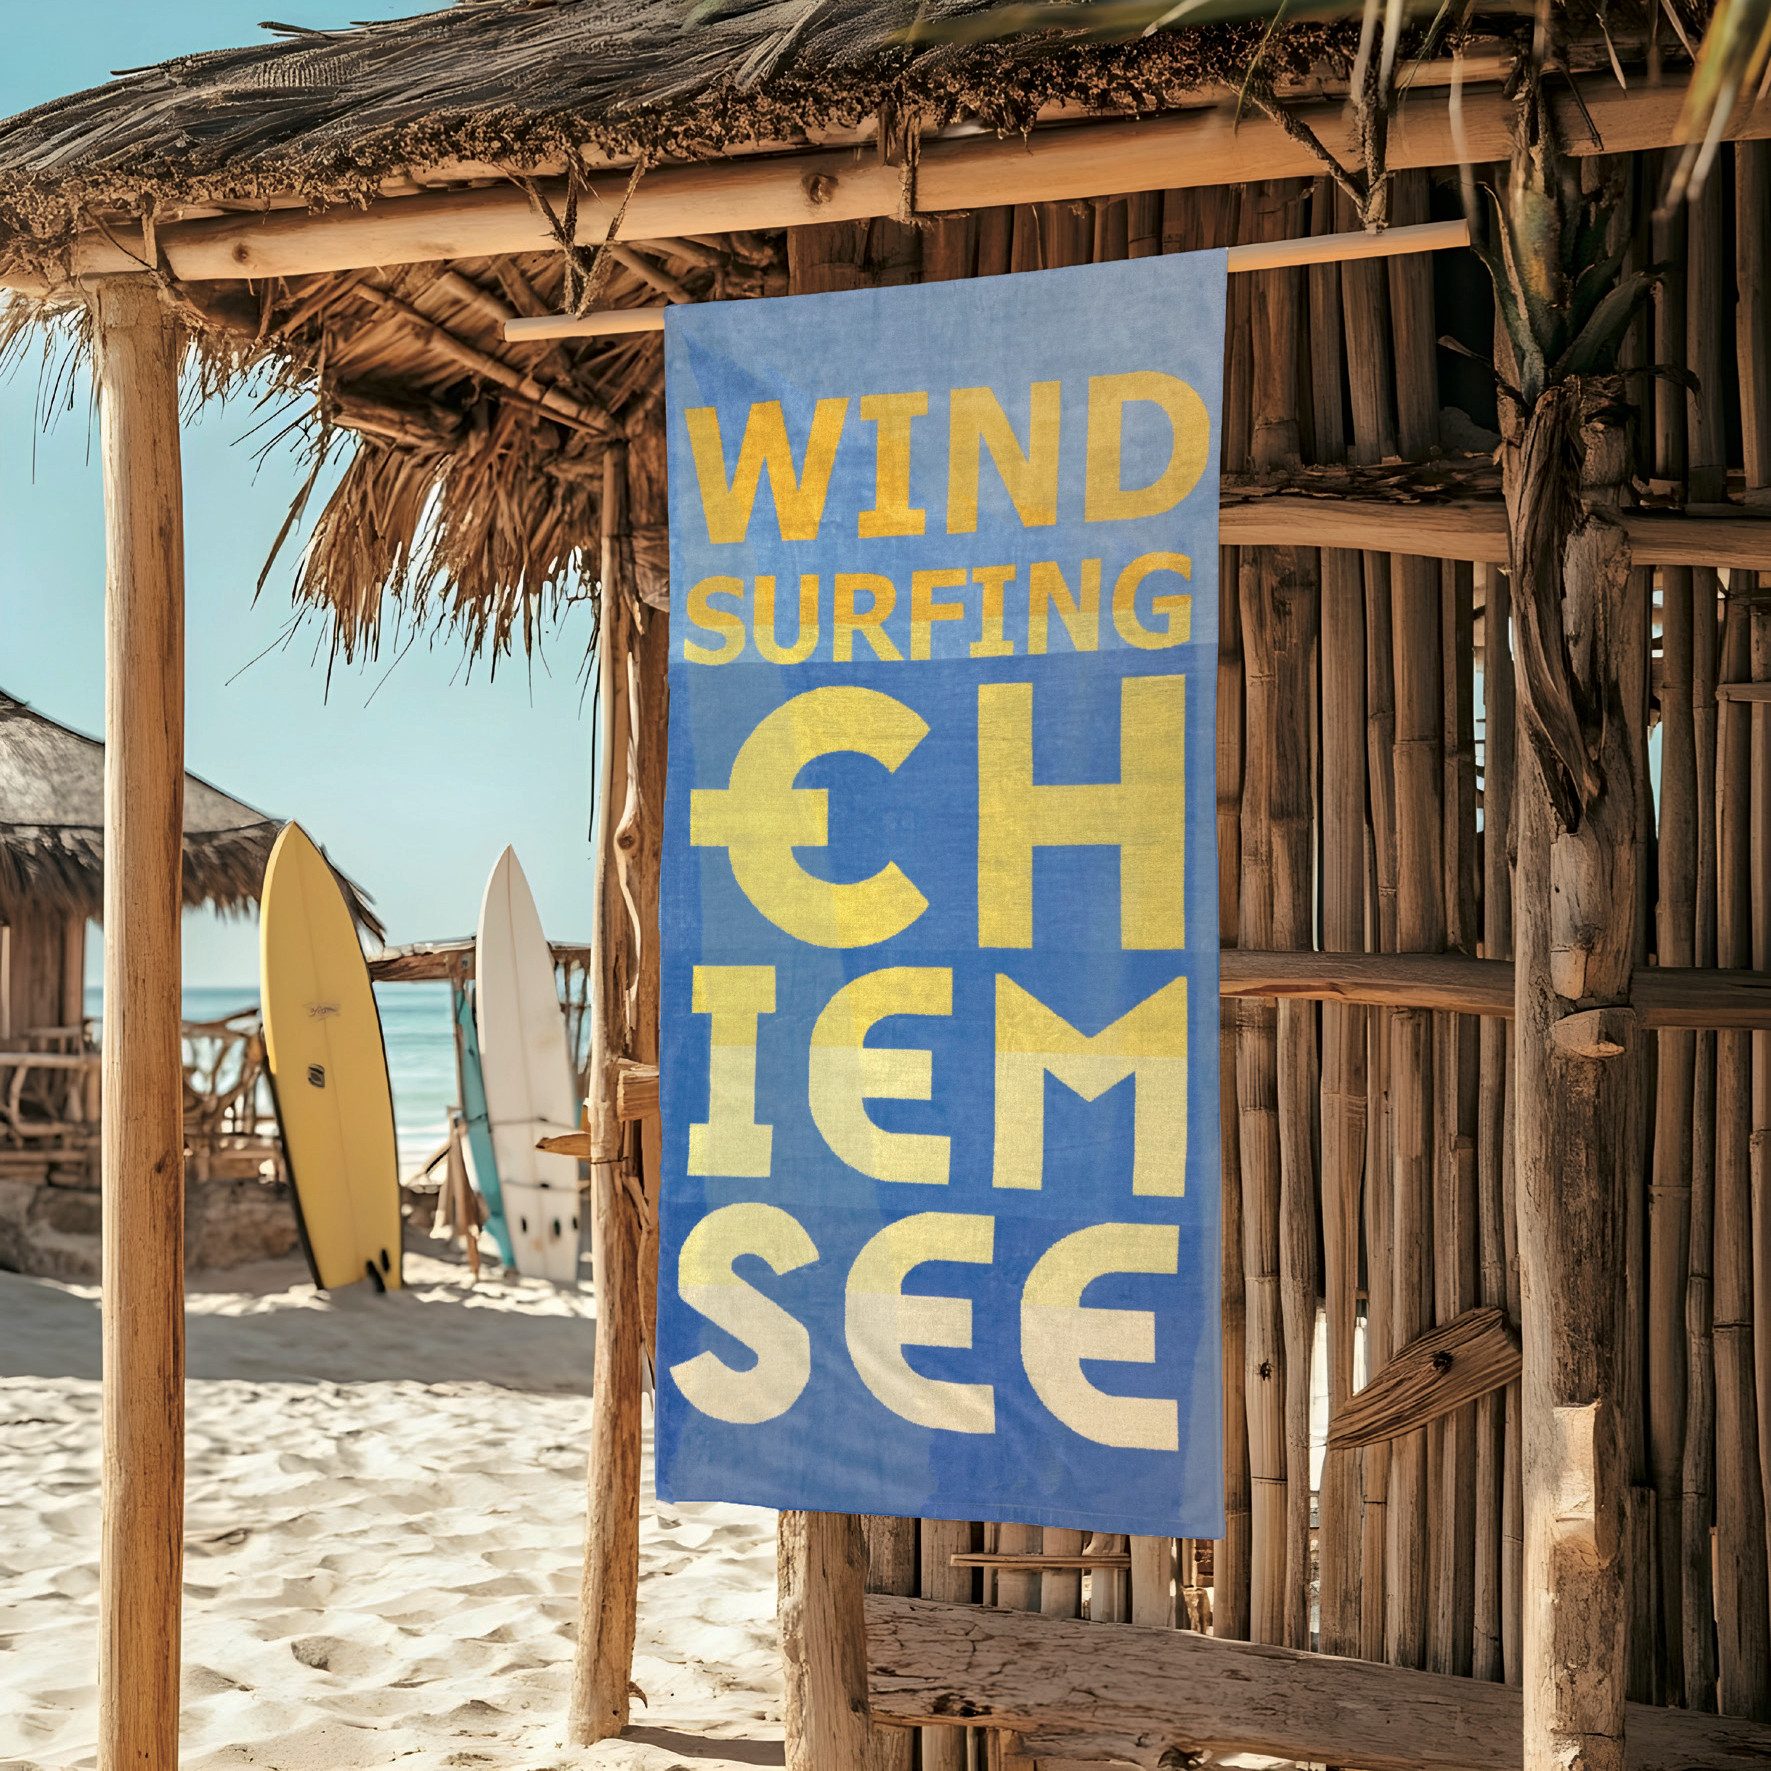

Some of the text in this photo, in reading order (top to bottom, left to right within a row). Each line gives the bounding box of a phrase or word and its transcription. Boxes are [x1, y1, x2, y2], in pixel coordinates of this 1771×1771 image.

[684, 370, 1211, 544] WIND
[684, 551, 1192, 665] SURFING
[688, 966, 1188, 1197] IEM
[671, 1203, 1180, 1451] SEE
